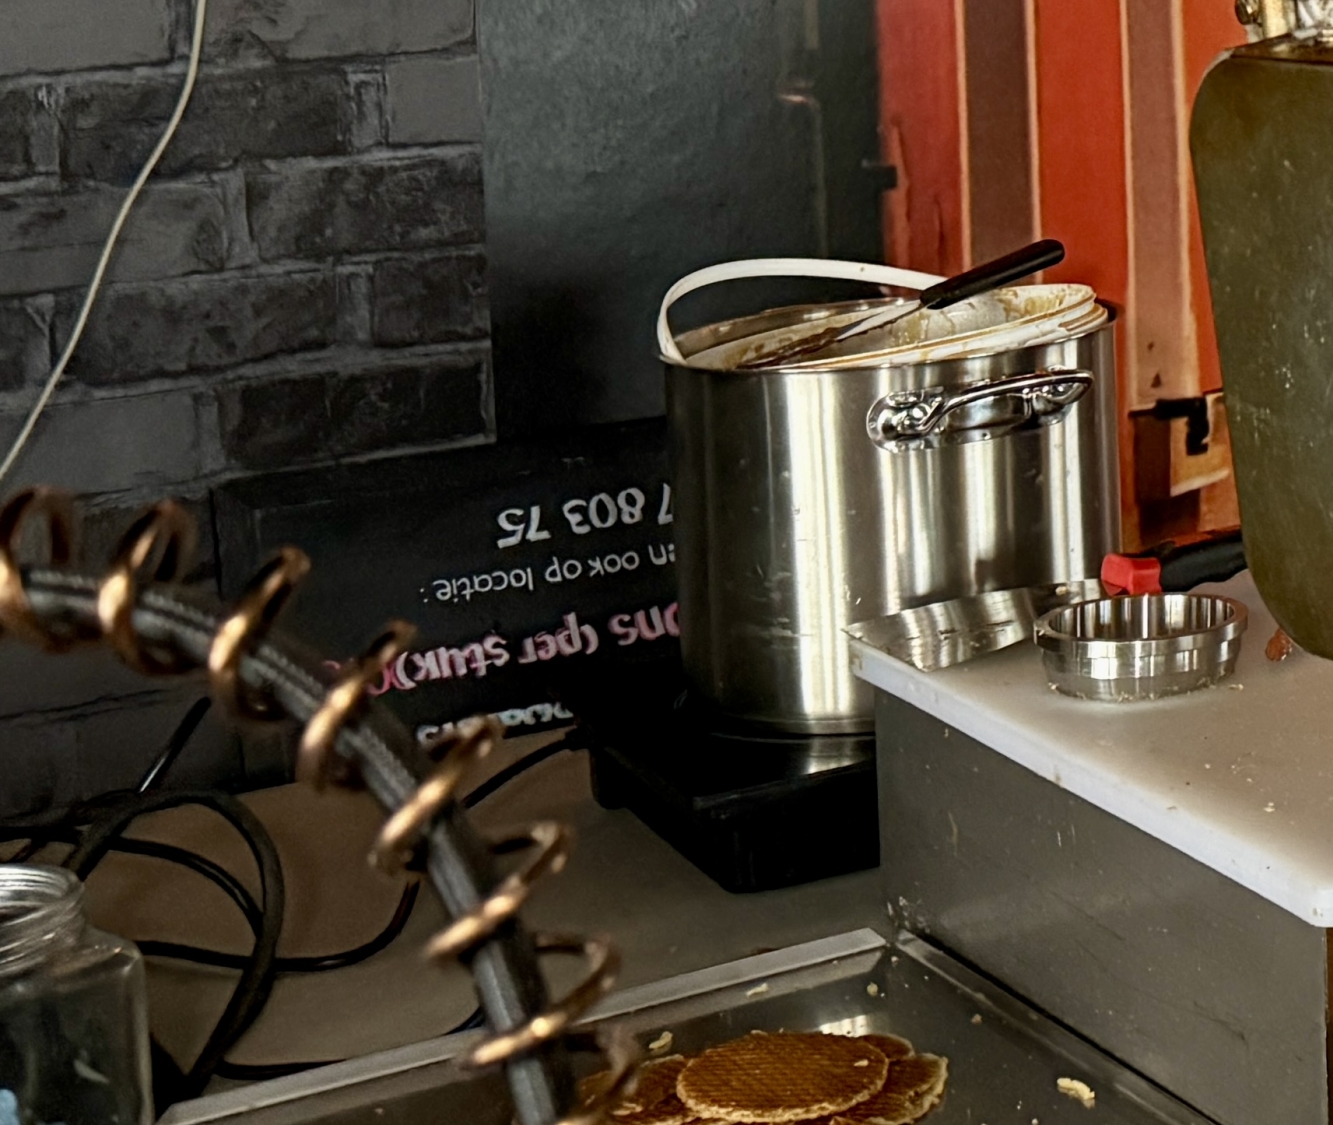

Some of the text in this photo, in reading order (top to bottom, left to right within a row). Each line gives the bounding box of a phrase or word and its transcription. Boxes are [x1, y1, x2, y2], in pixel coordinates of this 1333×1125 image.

[495, 504, 552, 550] 75
[561, 486, 646, 535] 803
[544, 556, 583, 584] op
[586, 550, 641, 579] ook
[394, 632, 511, 690] stuk)
[516, 611, 600, 665] (per
